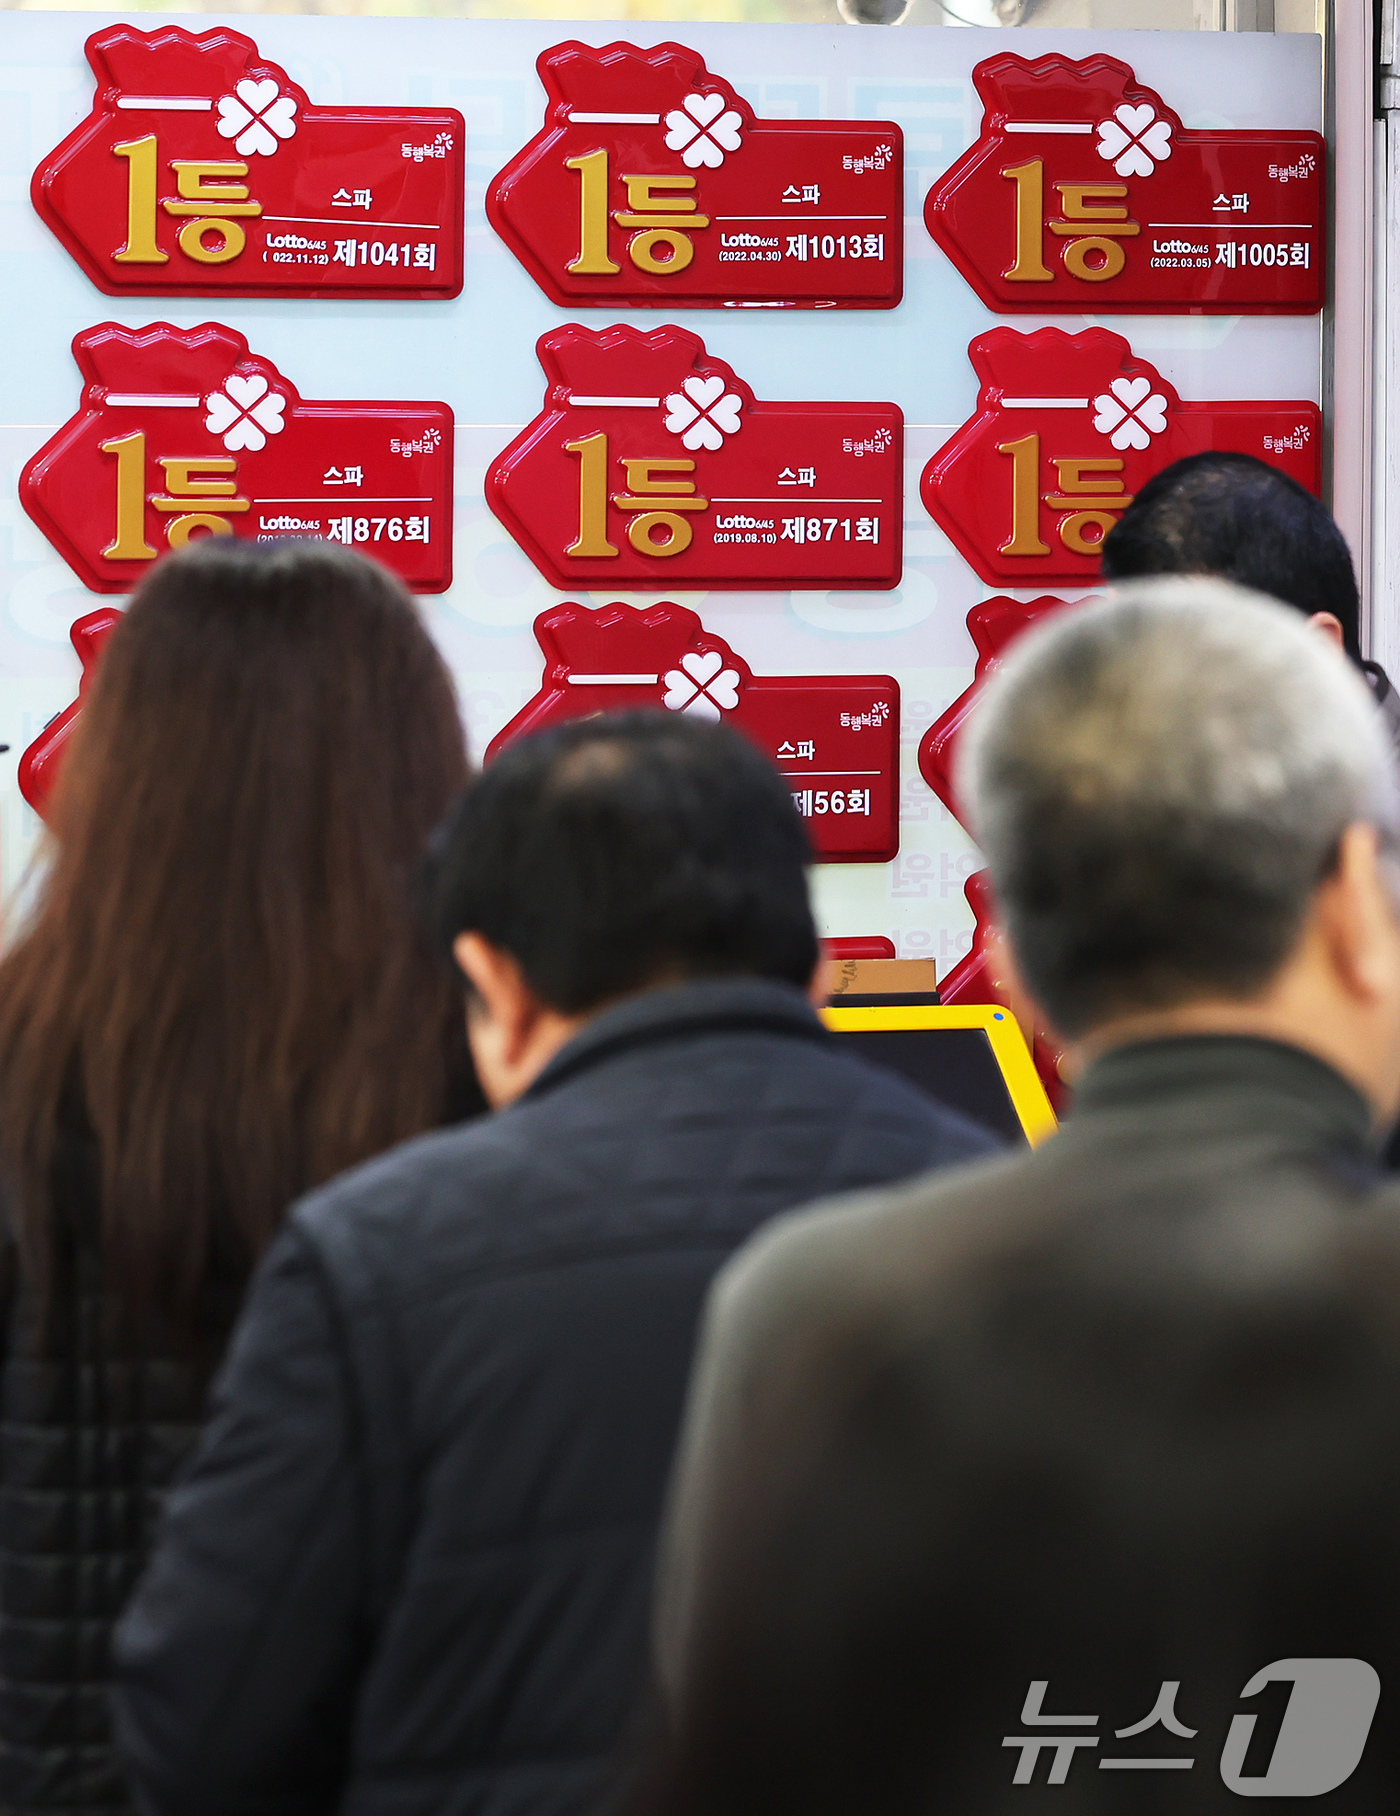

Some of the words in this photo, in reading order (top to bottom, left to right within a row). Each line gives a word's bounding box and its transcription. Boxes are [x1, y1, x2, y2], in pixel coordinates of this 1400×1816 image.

[401, 142, 447, 163] 동행복권
[842, 154, 885, 175] 동행복권
[1268, 163, 1308, 183] 동행복권
[112, 135, 263, 264] 1등
[331, 187, 373, 211] 스파
[781, 184, 821, 205] 스파
[1212, 192, 1250, 214] 스파
[565, 149, 710, 275] 1등
[1002, 159, 1141, 281] 1등
[332, 238, 437, 272] 제1041회
[718, 250, 782, 262] (2022.04.30)
[785, 233, 884, 262] 제1013회
[1214, 241, 1310, 270] 제1005회
[1150, 256, 1212, 269] (2022.03.05)
[389, 437, 434, 458] 동행복권
[842, 437, 885, 457] 동행복권
[1263, 434, 1303, 454] 동행복권
[322, 465, 364, 487] 스파
[777, 466, 817, 488] 스파
[101, 431, 251, 560] 1등
[566, 432, 710, 558] 1등
[998, 433, 1133, 556] 1등
[326, 515, 431, 550] 제876회
[713, 532, 777, 545] (2019.08.10)
[779, 516, 880, 545] 제871회
[839, 711, 882, 731] 동행복권
[776, 739, 816, 761] 스파
